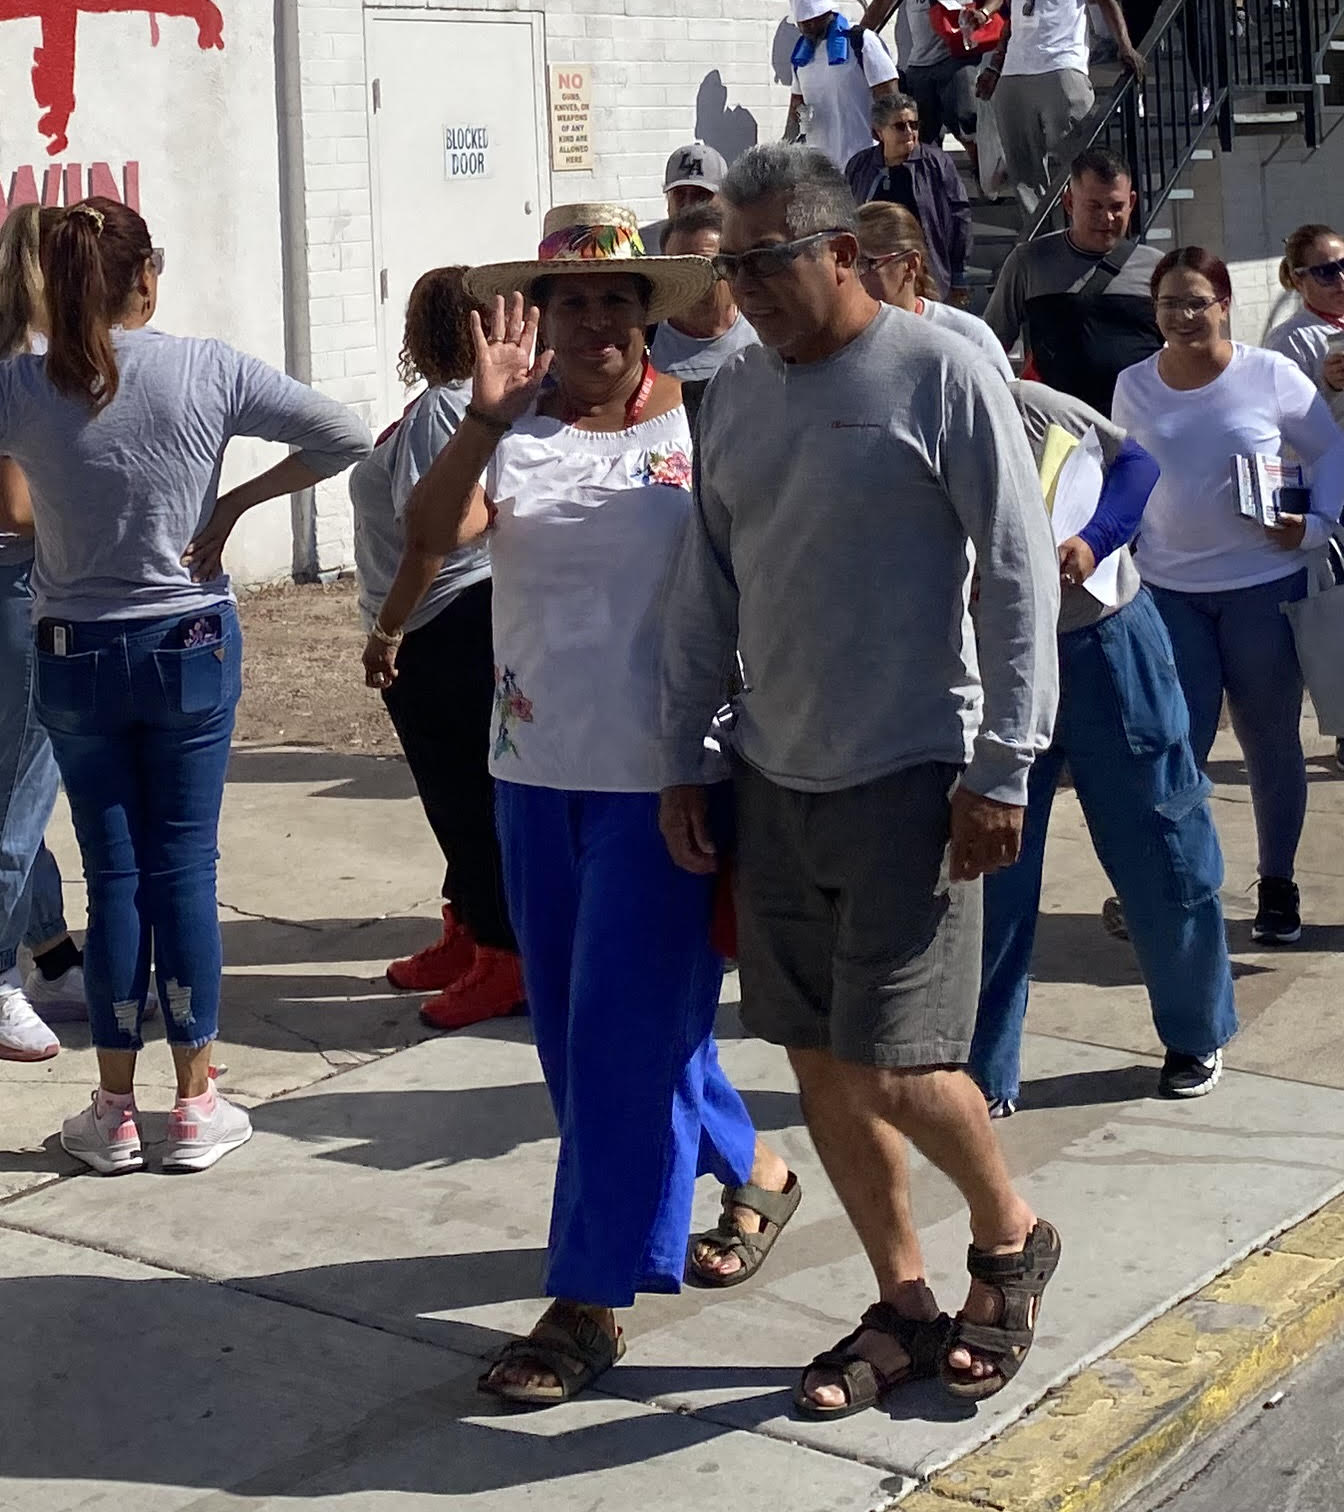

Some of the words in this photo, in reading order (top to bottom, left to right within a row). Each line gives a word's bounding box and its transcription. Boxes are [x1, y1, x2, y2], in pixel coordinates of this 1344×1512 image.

[558, 73, 583, 90] NO
[561, 93, 582, 101] GUNS,
[554, 104, 580, 112] KNIVES,
[557, 114, 588, 122] WEAPONS
[561, 125, 570, 133] OF
[446, 127, 489, 150] BLOCKED
[559, 135, 575, 143] KIND
[559, 145, 589, 153] ALLOWED
[565, 155, 583, 164] HERE
[452, 152, 485, 176] DOOR
[679, 150, 705, 178] LA
